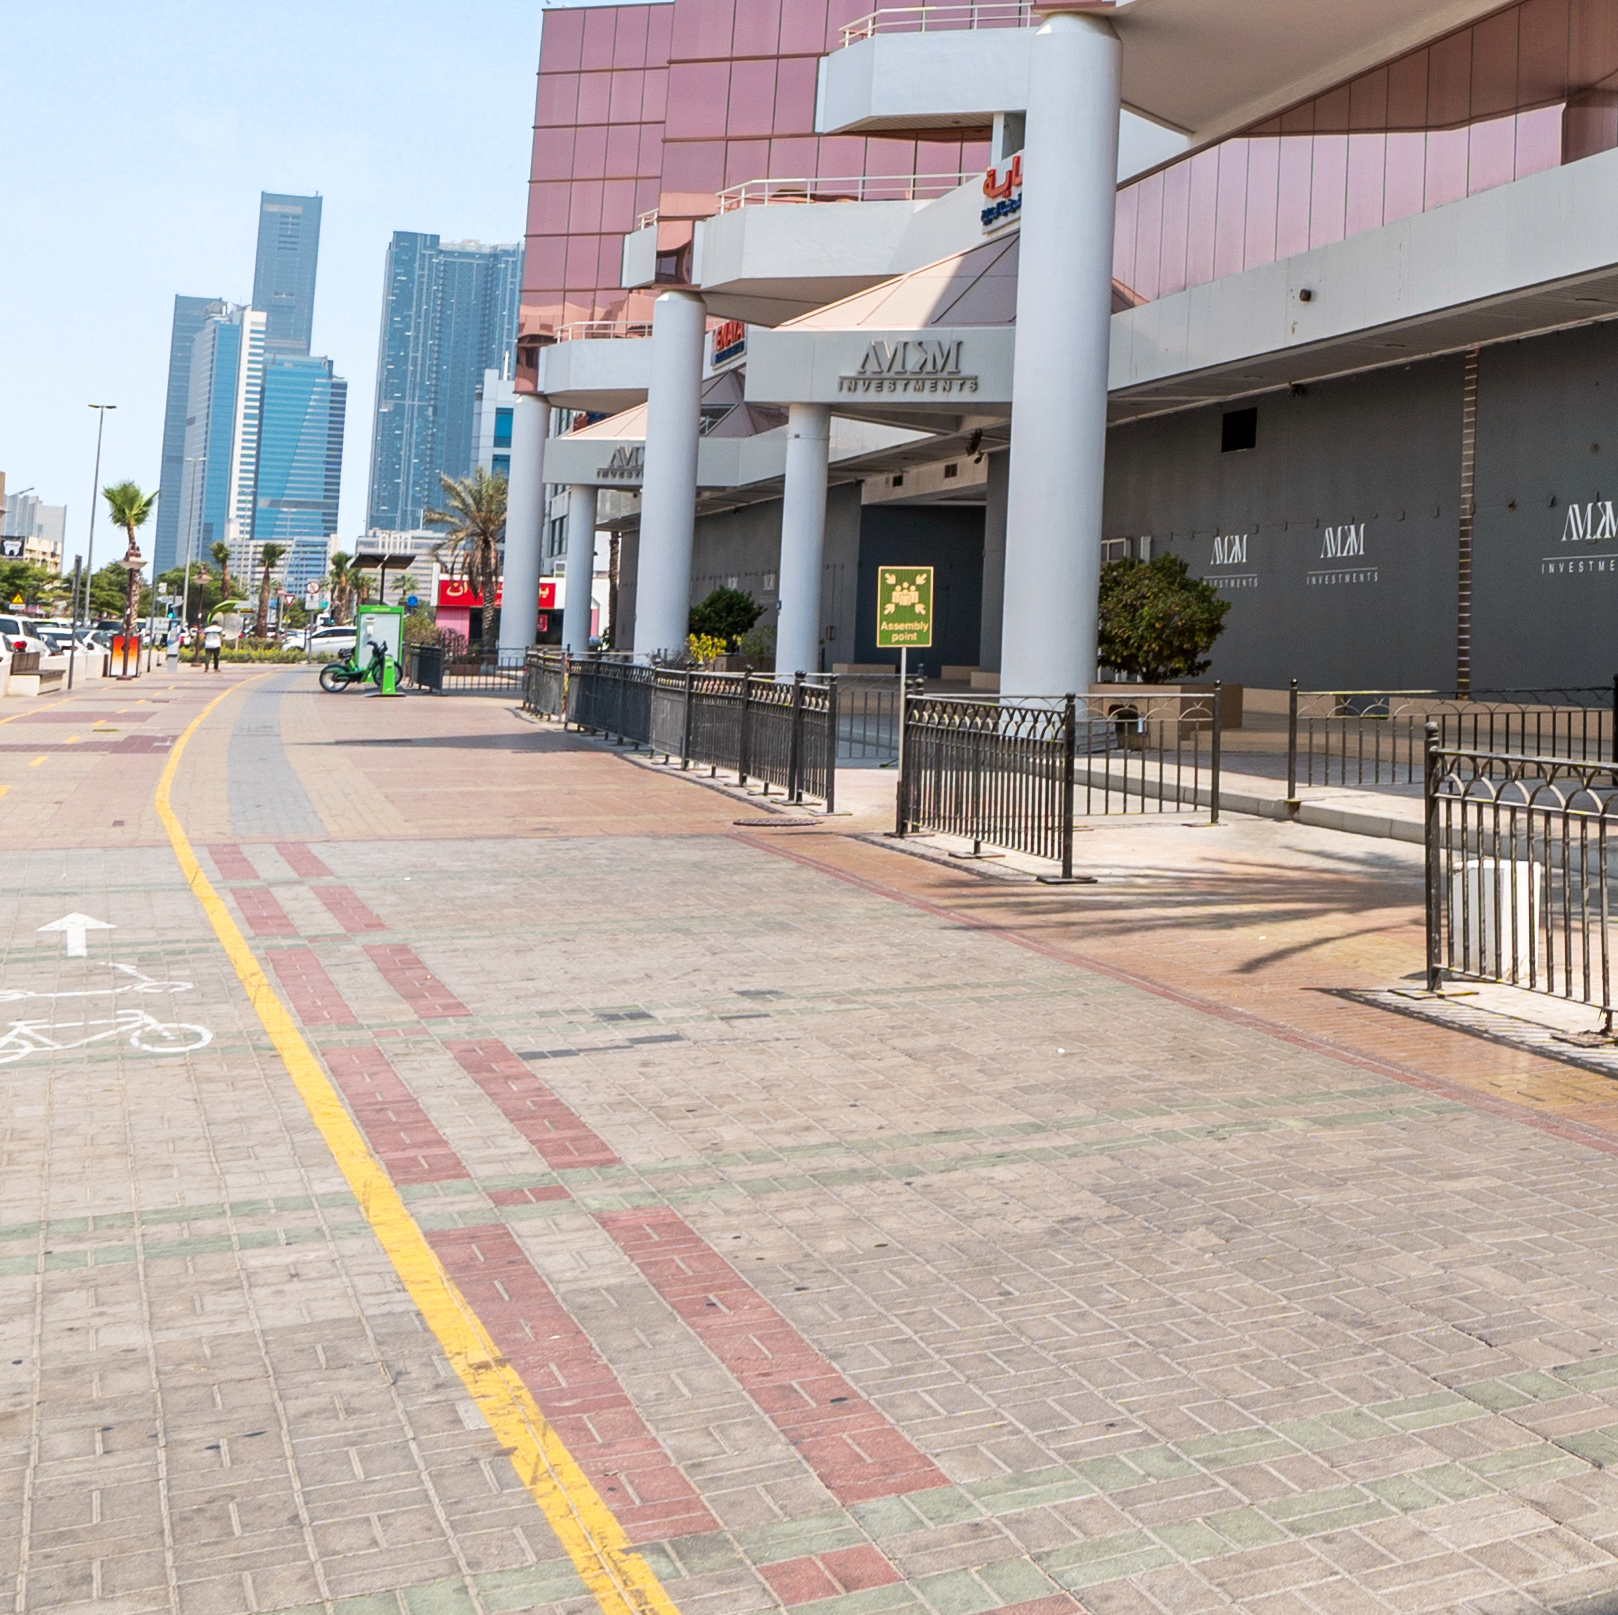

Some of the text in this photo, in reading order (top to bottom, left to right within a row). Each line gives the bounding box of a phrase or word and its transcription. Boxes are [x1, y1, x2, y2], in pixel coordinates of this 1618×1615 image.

[838, 380, 978, 392] INVESTMENTS
[597, 470, 643, 479] INVEST
[1203, 577, 1258, 589] NVESTMENTS
[1306, 572, 1379, 585] INVESTMENTS
[881, 621, 929, 633] Assembly
[891, 632, 917, 643] point
